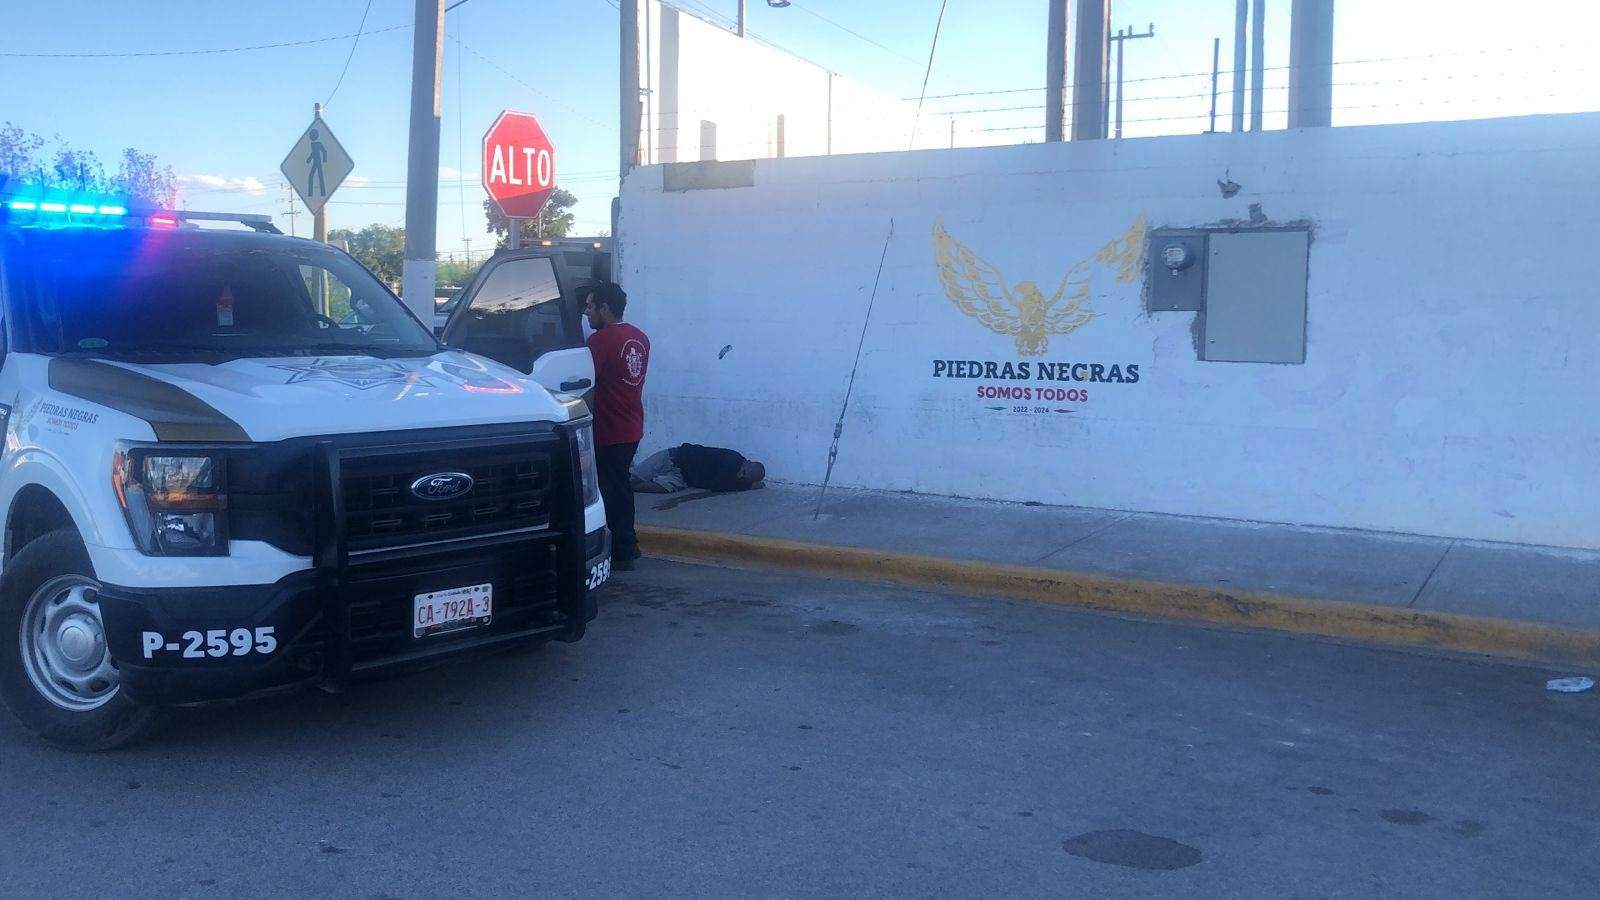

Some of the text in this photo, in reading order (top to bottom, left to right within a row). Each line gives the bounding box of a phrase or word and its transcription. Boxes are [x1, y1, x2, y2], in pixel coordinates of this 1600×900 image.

[489, 144, 551, 187] ALTO
[933, 359, 1140, 384] PIEDRAS NEGRAS
[977, 385, 1088, 402] SOMOS TODOS
[40, 402, 99, 424] PIEDRAS NEGRAS
[1012, 405, 1029, 413] 2022
[1033, 406, 1050, 414] 2024
[428, 478, 461, 495] Ford
[418, 596, 490, 624] CA-792A-3
[142, 626, 277, 659] P-2595
